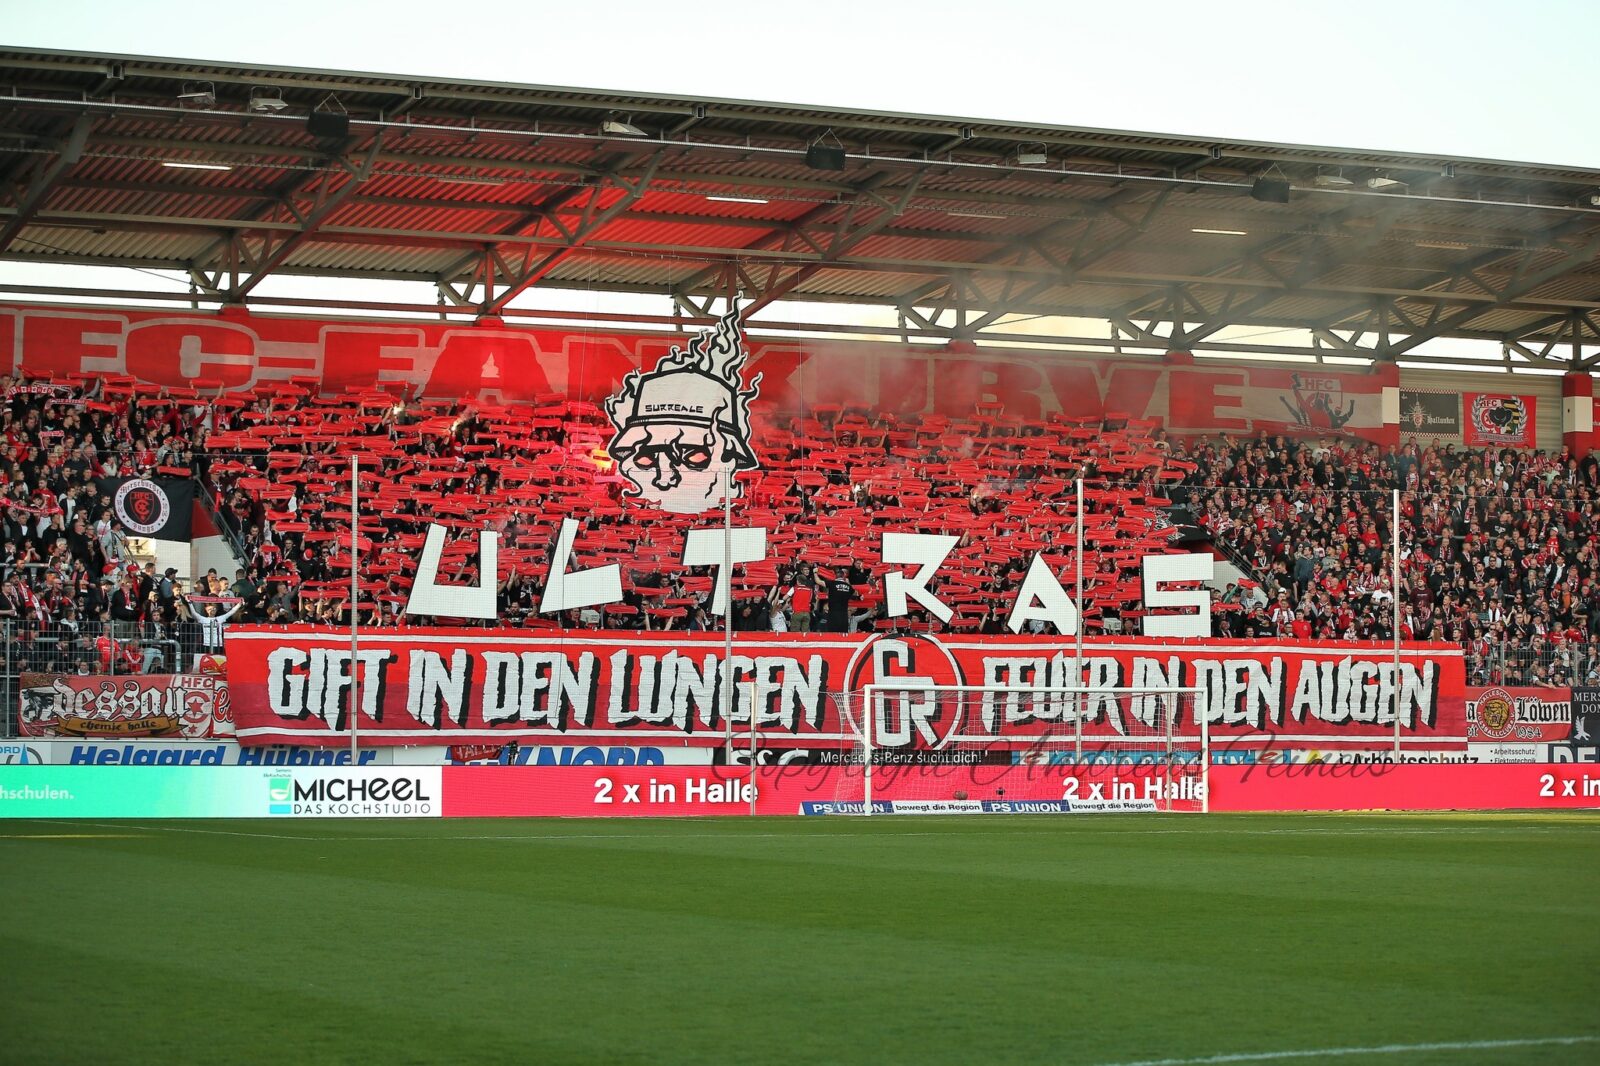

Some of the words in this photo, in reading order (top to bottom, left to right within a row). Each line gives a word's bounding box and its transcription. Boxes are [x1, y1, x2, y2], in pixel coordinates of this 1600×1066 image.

[644, 403, 704, 413] SURREALE
[181, 676, 214, 688] HFC
[267, 647, 397, 731] GIFT
[407, 648, 475, 730] IN
[482, 651, 596, 732] DEN
[608, 648, 828, 733] LUNGEN
[982, 651, 1128, 736] FEUER
[1129, 655, 1187, 735] IN
[1190, 655, 1286, 731] DEN
[1291, 655, 1440, 731] AUGEN
[1479, 690, 1513, 706] HALLESCHER
[1515, 697, 1570, 722] Löwen
[820, 751, 916, 764] Merceds-Benz
[953, 751, 982, 764] dich!
[593, 778, 613, 803] 2
[622, 783, 641, 803] x
[650, 779, 676, 803] in
[685, 778, 758, 803] Halle
[1062, 777, 1080, 800] 2
[1088, 781, 1105, 800] x
[1112, 777, 1136, 800] in
[1144, 777, 1208, 800] Halle
[1539, 774, 1555, 796] 2
[1561, 780, 1576, 796] x
[294, 803, 323, 814] DAS
[329, 803, 431, 814] KOCHSTUDIO
[812, 803, 833, 813] PS
[895, 804, 930, 812] bewegt
[932, 803, 946, 812] die
[948, 803, 980, 813] Region
[991, 803, 1011, 812] PS
[1015, 803, 1061, 812] UNION
[1071, 802, 1106, 811] bewegt
[1108, 802, 1121, 810] die
[1123, 801, 1155, 811] Region
